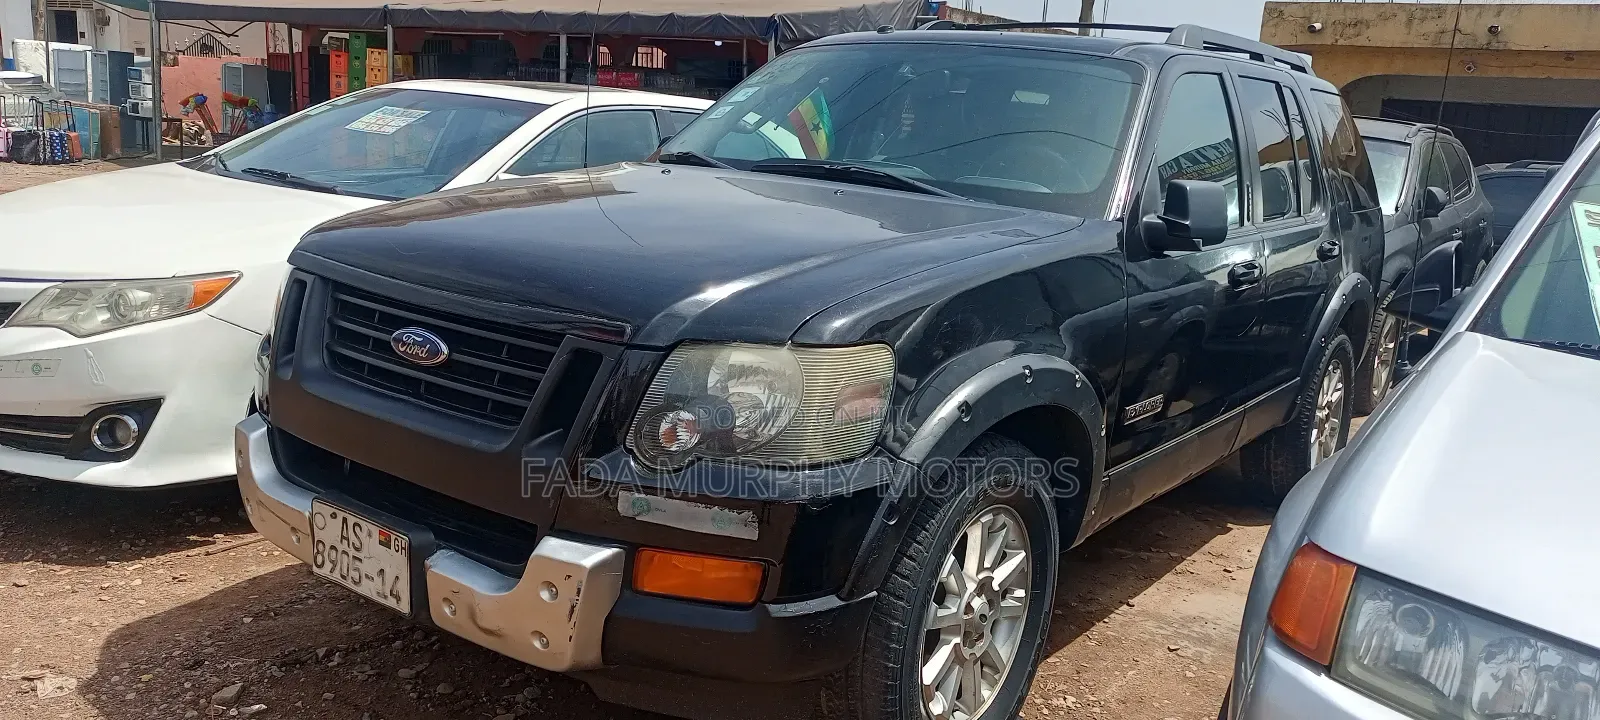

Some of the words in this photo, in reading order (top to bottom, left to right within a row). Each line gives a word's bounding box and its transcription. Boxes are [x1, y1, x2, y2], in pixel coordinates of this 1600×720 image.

[399, 334, 430, 357] Ford
[341, 517, 362, 552] AS
[394, 538, 407, 557] GH
[314, 540, 401, 604] 8905-14
